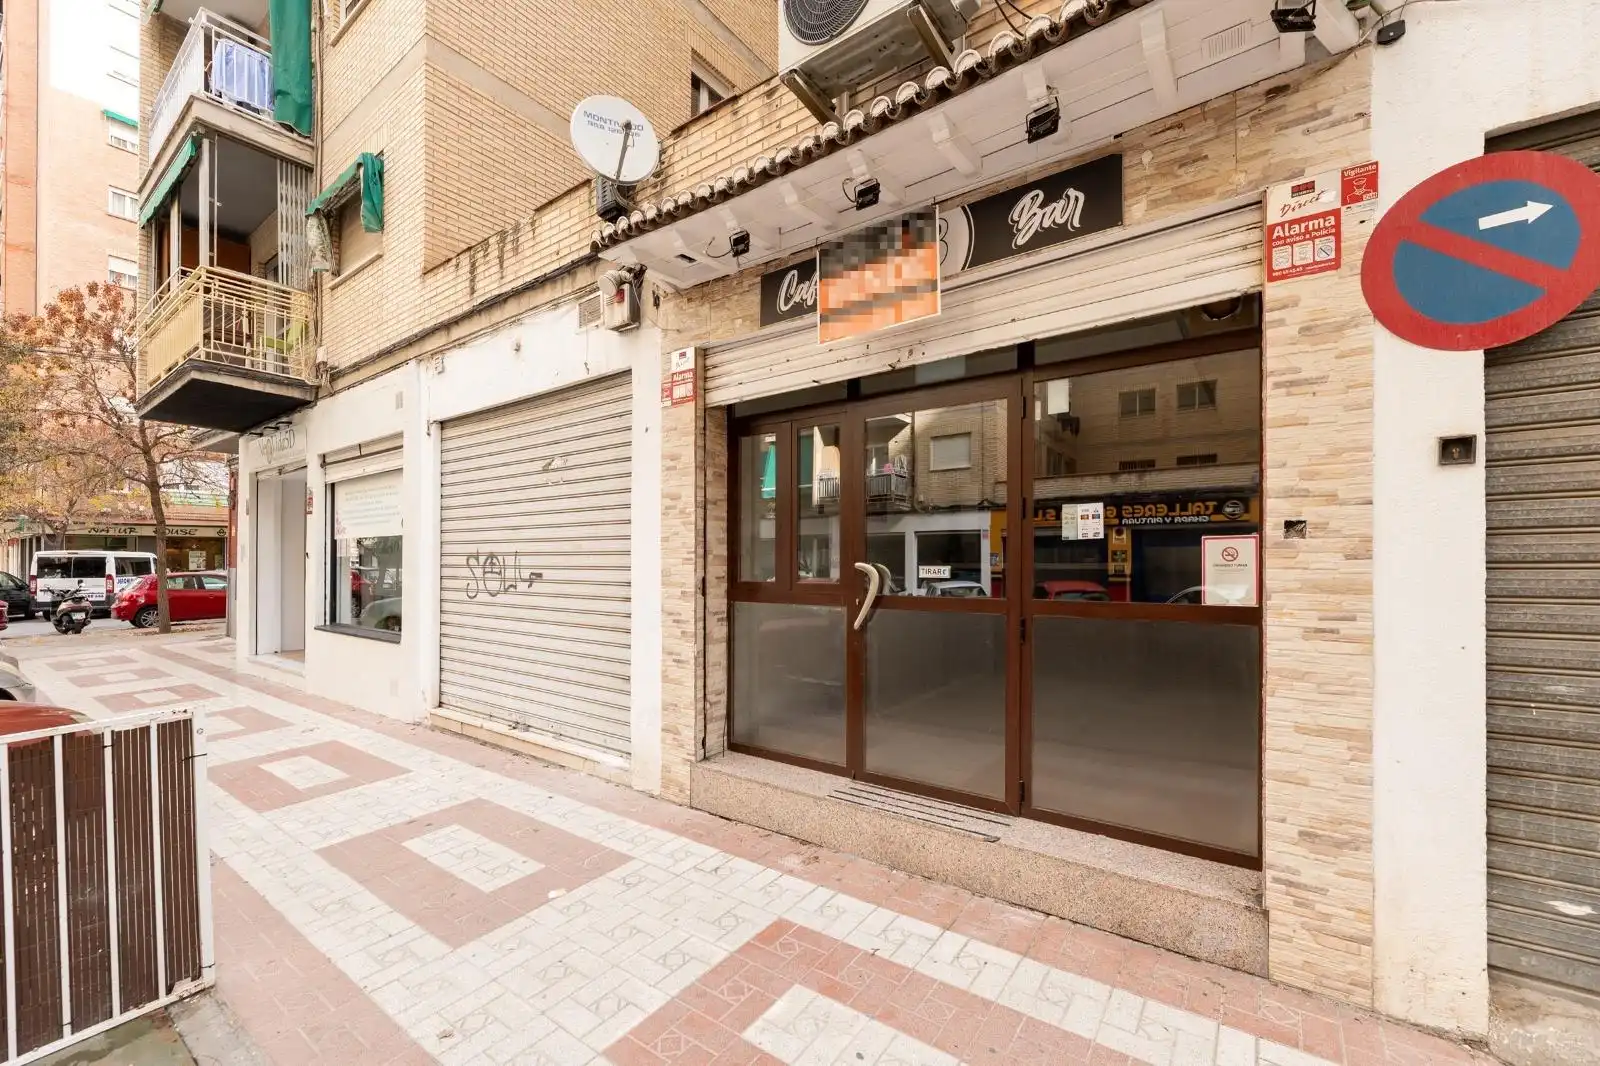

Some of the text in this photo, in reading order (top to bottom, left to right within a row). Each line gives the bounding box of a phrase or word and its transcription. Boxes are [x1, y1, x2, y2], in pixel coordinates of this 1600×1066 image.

[1344, 164, 1377, 177] Vigilante
[1009, 187, 1085, 250] Bar
[1272, 215, 1336, 240] Alarma
[1272, 239, 1285, 247] con
[1286, 234, 1304, 244] aviso
[777, 269, 818, 314] Caf
